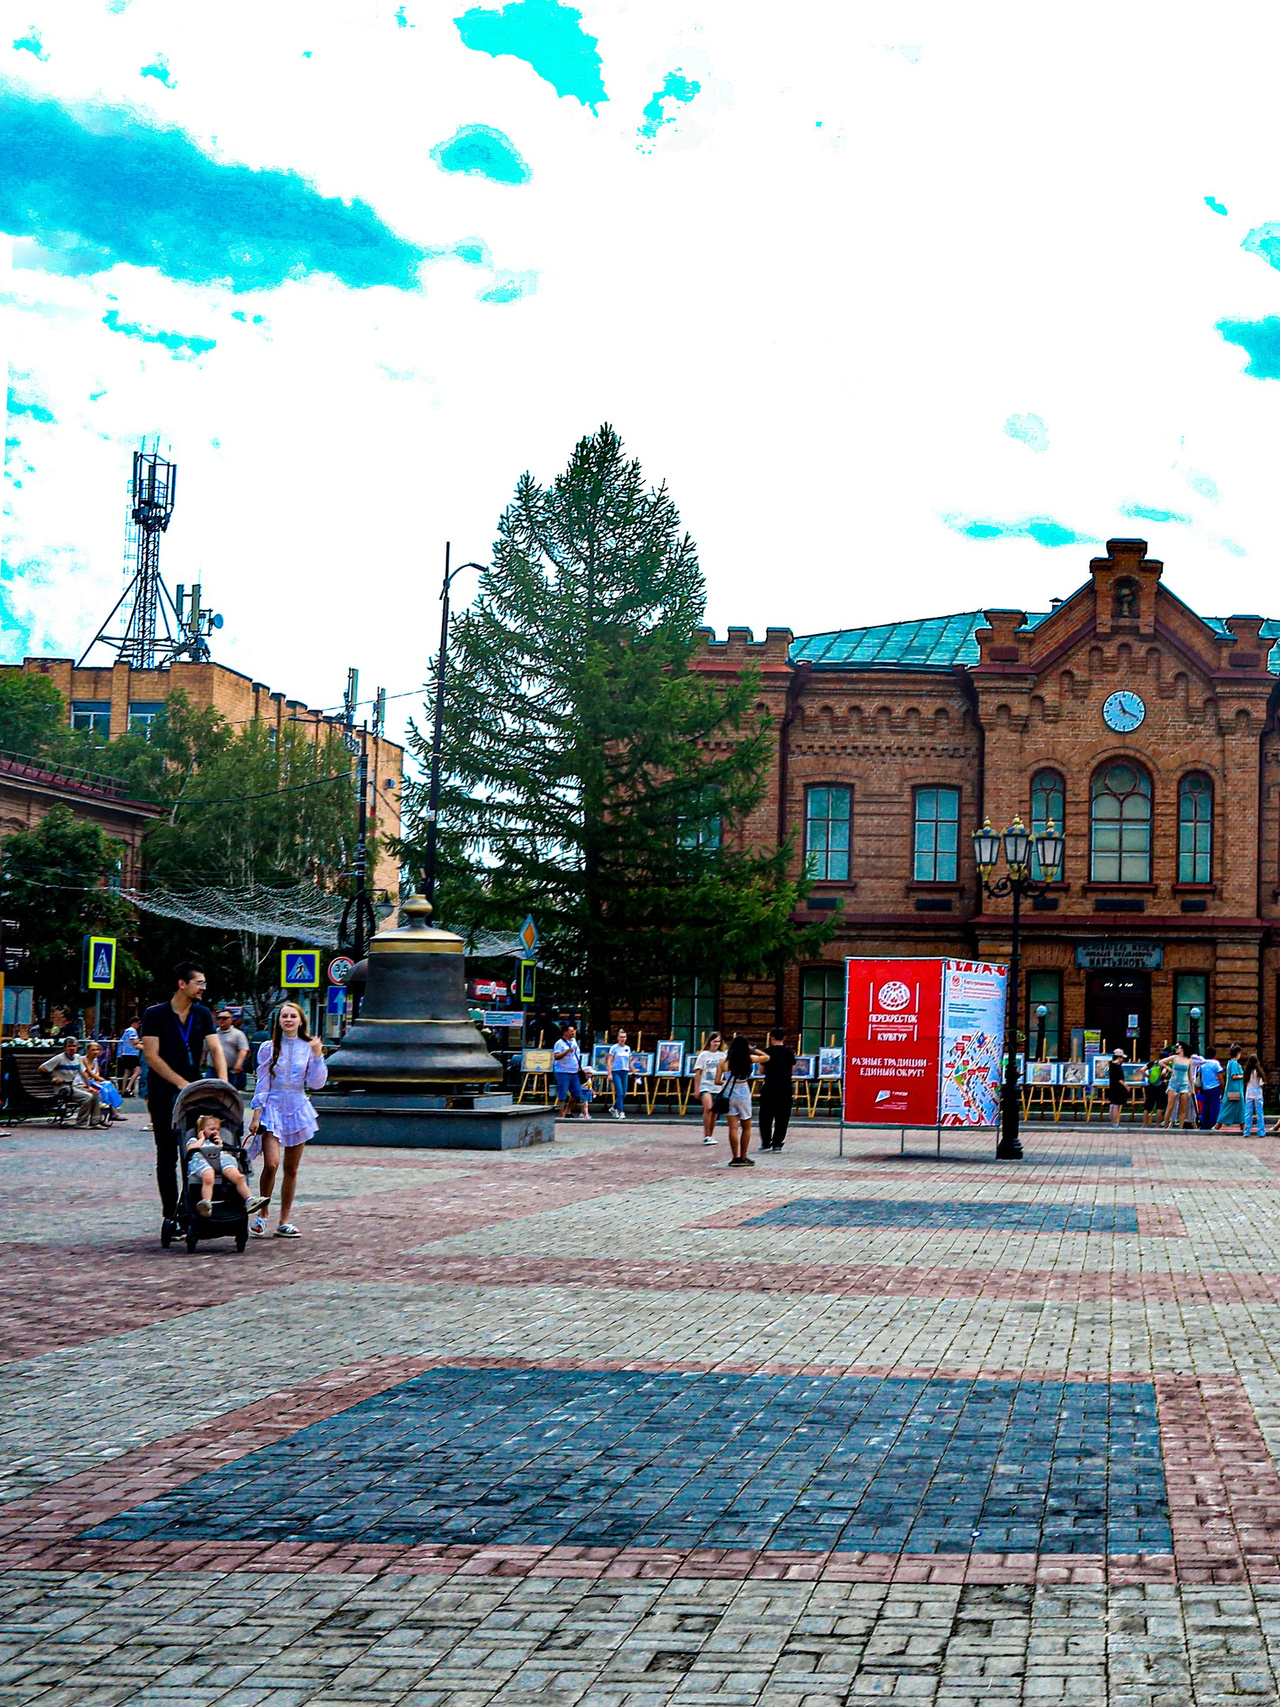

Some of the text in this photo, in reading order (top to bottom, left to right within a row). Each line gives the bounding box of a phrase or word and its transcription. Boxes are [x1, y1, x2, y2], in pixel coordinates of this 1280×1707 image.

[869, 1014, 918, 1023] ПЕРЕКРЕСТОК
[851, 1056, 883, 1066] РАЗНЫЕ
[883, 1057, 927, 1068] ТРАДИЦИИ
[859, 1066, 925, 1078] ЕДИНЫЙ ОКРУГ!
